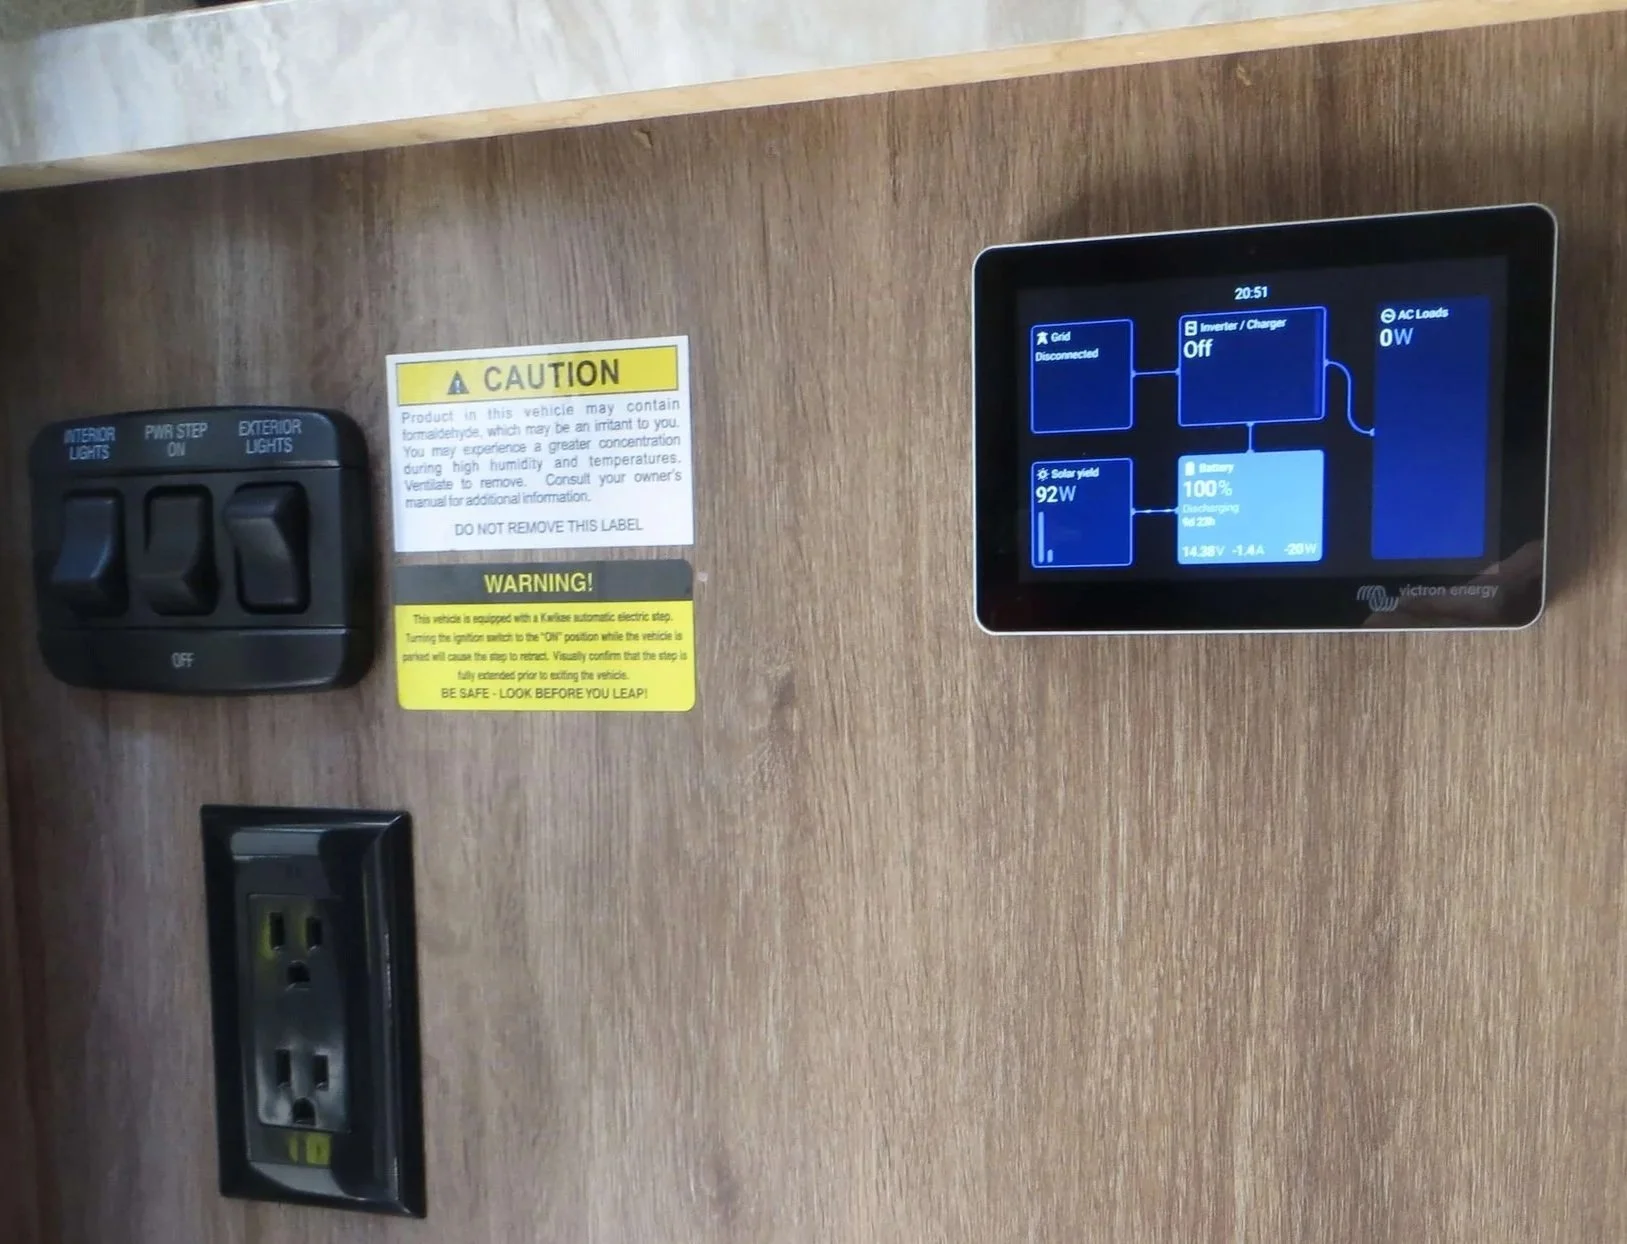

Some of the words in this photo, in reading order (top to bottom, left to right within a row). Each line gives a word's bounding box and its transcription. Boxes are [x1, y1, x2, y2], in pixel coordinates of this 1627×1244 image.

[1234, 286, 1268, 300] 20:51
[1397, 310, 1414, 320] AC
[1416, 307, 1449, 319] Loads
[1200, 321, 1238, 333] Inverter
[1246, 317, 1287, 331] Charger
[1050, 331, 1071, 343] Grid
[1379, 328, 1413, 348] 0W
[1035, 348, 1099, 362] Disconnected
[1183, 338, 1213, 359] Off
[484, 359, 619, 392] CAUTION
[402, 411, 453, 423] Product
[464, 409, 477, 420] in
[488, 407, 513, 420] this
[524, 404, 574, 418] vehicle
[586, 403, 615, 416] may
[626, 398, 680, 412] contain
[64, 427, 116, 444] INTERIOR
[145, 424, 173, 439] PWR
[176, 422, 208, 438] STEP
[239, 419, 302, 436] EXTERIOR
[402, 426, 483, 441] formaldehyde,
[487, 423, 521, 437] which
[525, 422, 551, 437] may
[555, 421, 570, 434] be
[575, 422, 589, 432] an
[595, 419, 633, 431] irritant
[637, 418, 650, 429] to
[653, 418, 680, 432] you.
[69, 444, 110, 461] LIGHTS
[167, 441, 186, 457] ON
[245, 437, 293, 454] LIGHTS
[403, 446, 425, 458] You
[432, 446, 456, 459] may
[463, 441, 527, 456] experience
[534, 442, 542, 452] a
[548, 438, 591, 454] greater
[598, 433, 680, 449] concentration
[404, 462, 442, 476] during
[453, 460, 479, 475] high
[490, 457, 543, 473] humidity
[555, 455, 578, 468] and
[589, 453, 682, 468] temperatures.
[1199, 463, 1235, 474] Battery
[405, 479, 453, 491] Ventilate
[461, 478, 473, 489] to
[480, 477, 527, 488] remove.
[546, 472, 591, 486] Consult
[599, 472, 626, 487] your
[634, 468, 682, 482] owner's
[1051, 470, 1076, 480] Solar
[1077, 467, 1100, 480] yield
[1035, 485, 1077, 503] 92W
[1182, 479, 1233, 498] 100%
[405, 496, 447, 508] manual
[449, 494, 464, 507] for
[466, 492, 520, 506] additional
[522, 490, 592, 504] information.
[1182, 503, 1240, 515] Discharging
[455, 523, 474, 536] DO
[478, 522, 503, 535] NOT
[508, 520, 564, 535] REMOVE
[568, 519, 598, 533] THIS
[601, 517, 643, 532] LABEL
[484, 573, 594, 593] WARNING!
[1400, 584, 1446, 597] victron
[1450, 585, 1499, 599] energy
[413, 613, 430, 624] This
[433, 613, 460, 623] vehicle
[463, 613, 471, 623] is
[473, 613, 511, 625] equipped
[514, 612, 531, 622] with
[574, 611, 615, 622] automatic
[617, 611, 649, 621] electric
[651, 612, 673, 623] step.
[406, 632, 436, 645] Turning
[438, 632, 451, 642] the
[453, 632, 484, 645] ignition
[487, 631, 513, 642] switch
[515, 632, 524, 642] to
[525, 631, 539, 641] the
[564, 631, 599, 643] position
[601, 631, 624, 641] while
[626, 631, 639, 641] the
[642, 630, 672, 641] vehicle
[674, 629, 683, 641] is
[171, 653, 195, 668] OFF
[402, 652, 430, 663] parked
[432, 651, 446, 661] will
[448, 653, 472, 661] cause
[474, 652, 487, 661] the
[489, 652, 507, 663] step
[509, 652, 518, 661] to
[520, 651, 549, 661] retract.
[553, 650, 586, 662] Visually
[588, 650, 622, 661] confirm
[624, 651, 640, 660] that
[642, 651, 657, 660] the
[659, 650, 678, 662] step
[680, 650, 688, 660] is
[457, 669, 475, 682] fully
[477, 670, 516, 681] extended
[517, 670, 538, 682] prior
[539, 670, 548, 680] to
[550, 670, 579, 682] exiting
[581, 670, 594, 680] the
[597, 669, 630, 680] vehicle.
[441, 687, 457, 699] BE
[459, 687, 490, 699] SAFE
[499, 687, 532, 698] LOOK
[535, 687, 583, 699] BEFORE
[586, 687, 609, 699] YOU
[612, 687, 648, 699] LEAP!
